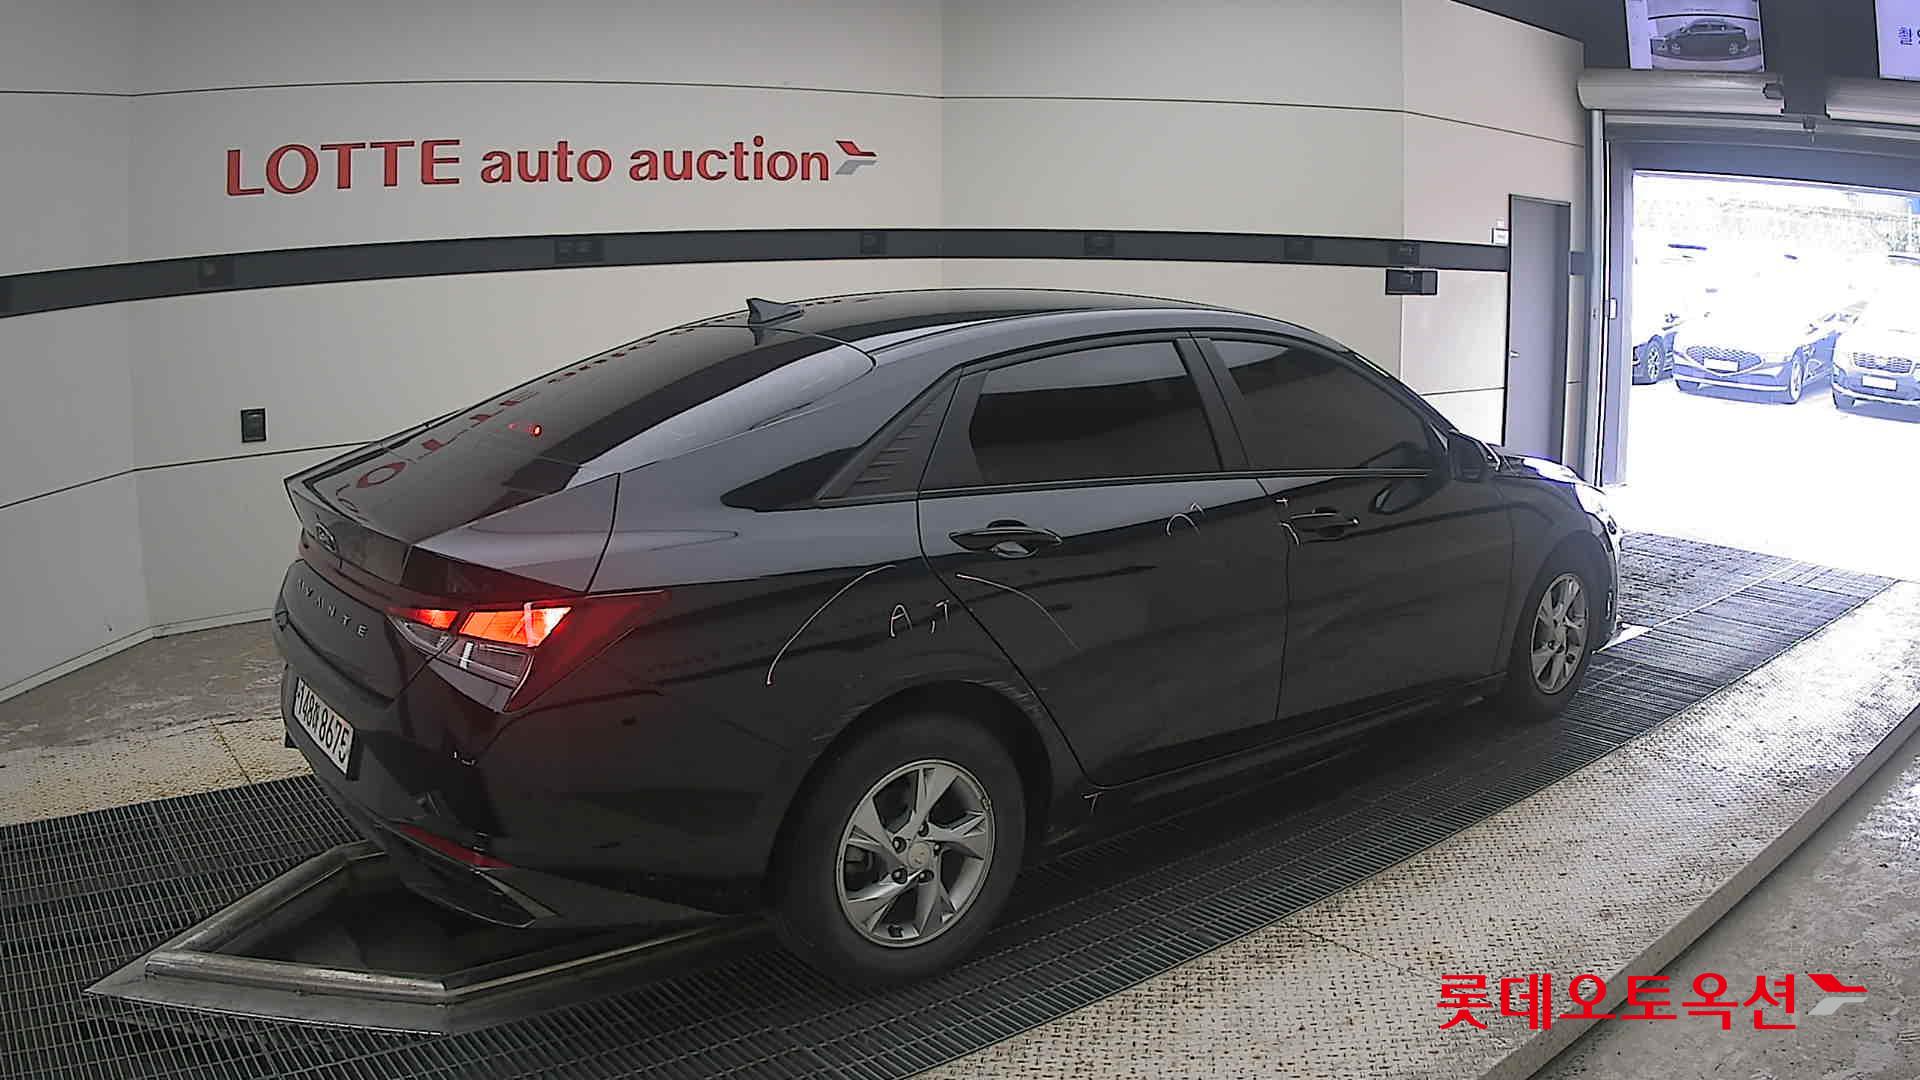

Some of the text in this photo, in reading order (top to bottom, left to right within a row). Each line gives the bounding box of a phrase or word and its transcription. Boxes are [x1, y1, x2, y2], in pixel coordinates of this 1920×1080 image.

[226, 136, 830, 196] LOTTE auto auction
[318, 708, 350, 764] 8675
